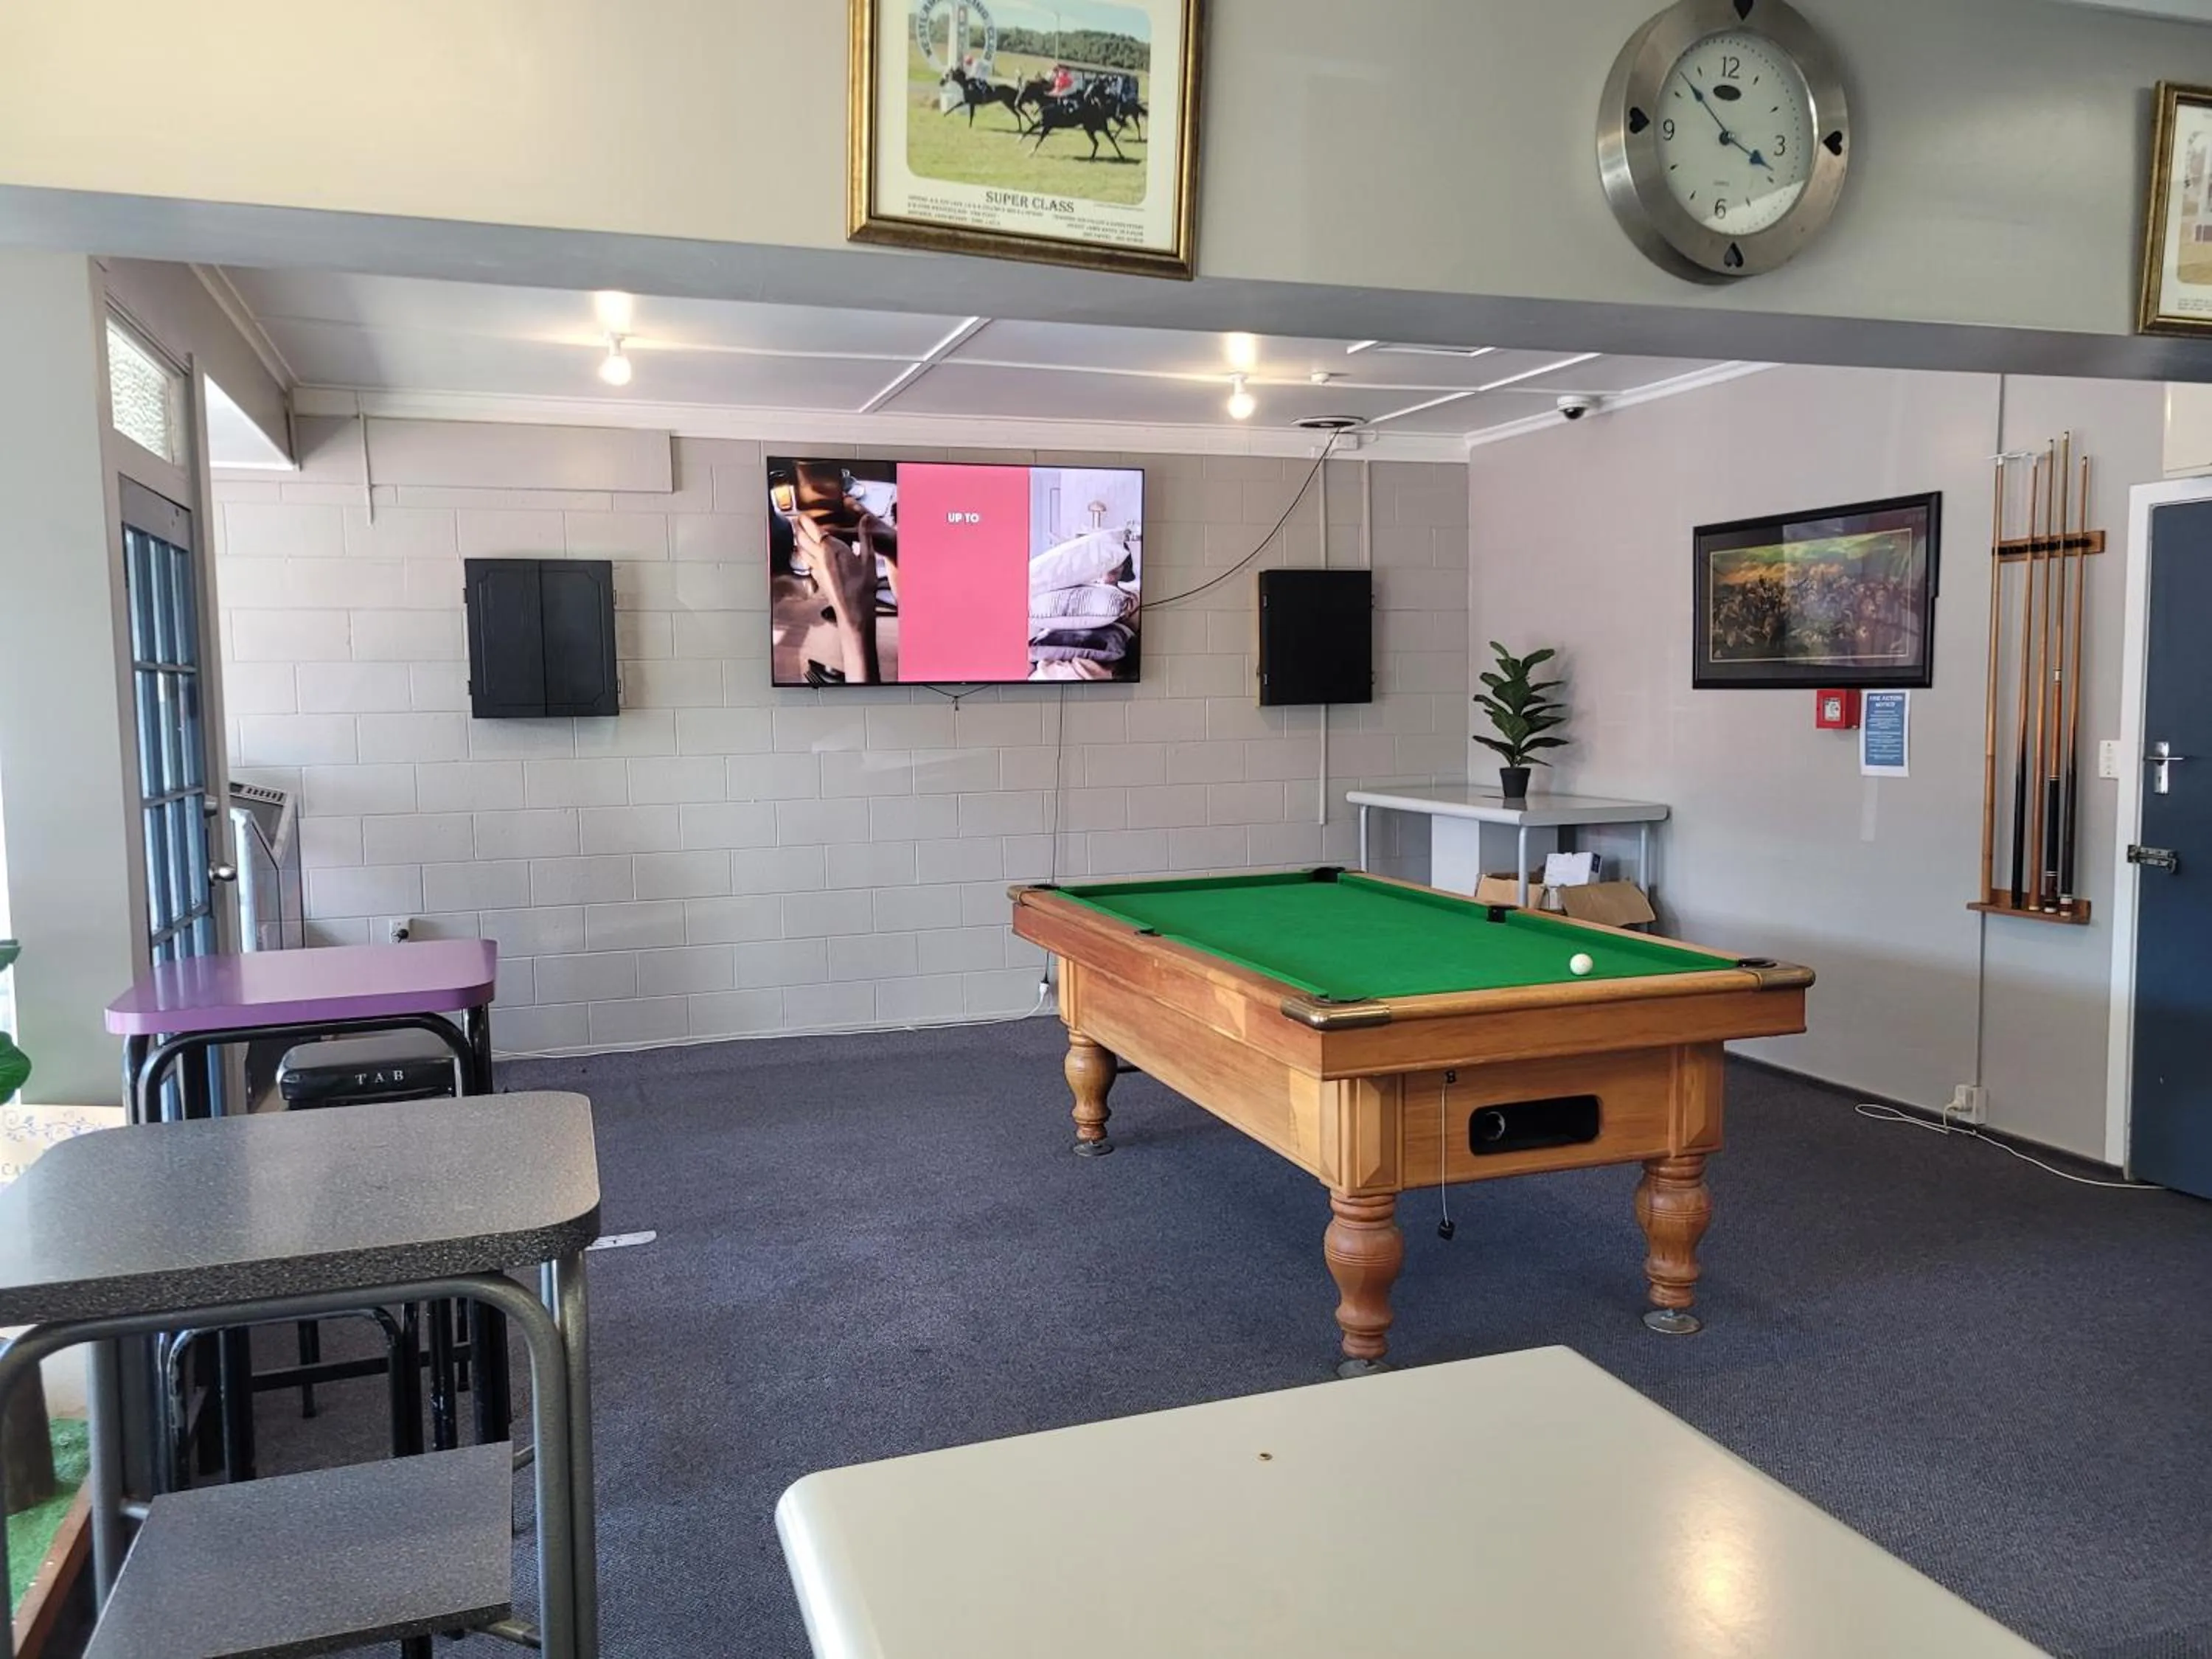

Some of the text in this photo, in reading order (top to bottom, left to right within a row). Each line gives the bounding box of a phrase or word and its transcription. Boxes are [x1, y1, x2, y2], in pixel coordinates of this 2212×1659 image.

[1722, 56, 1740, 79] 12
[1663, 119, 1675, 141] 9
[1774, 135, 1786, 156] 3
[985, 191, 1029, 209] SUPER
[1032, 197, 1074, 213] CLASS
[1714, 198, 1727, 220] 6
[947, 512, 979, 523] UP TO
[355, 1070, 405, 1085] TAB
